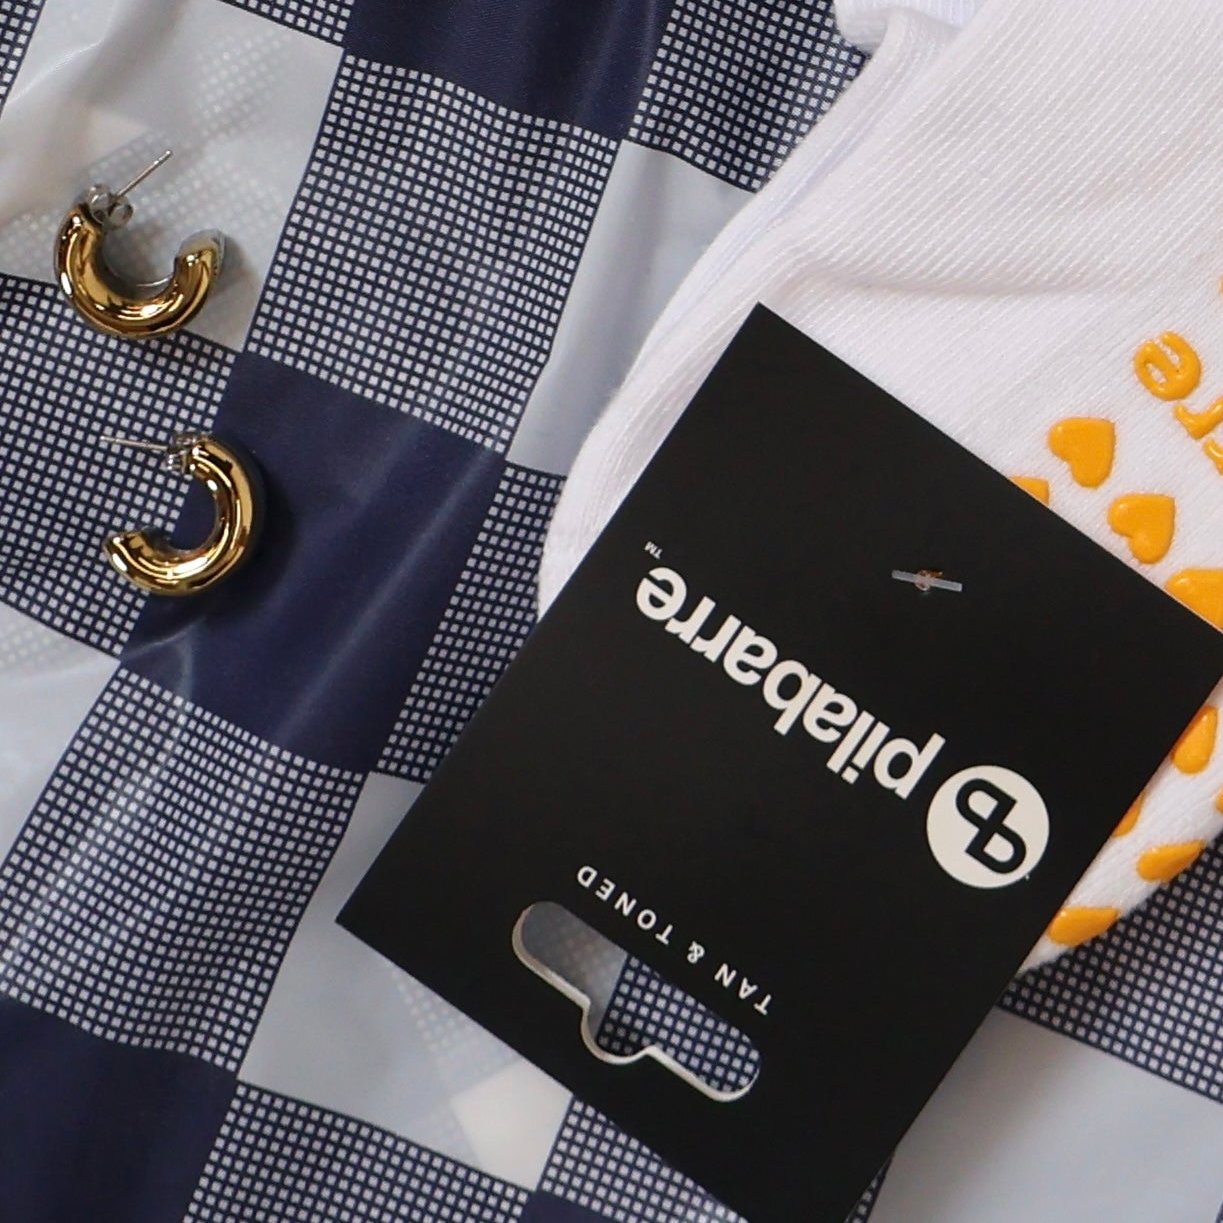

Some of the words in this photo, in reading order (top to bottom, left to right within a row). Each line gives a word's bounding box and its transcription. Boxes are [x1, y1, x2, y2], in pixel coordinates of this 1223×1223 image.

[635, 566, 946, 800] pilabarre
[576, 865, 673, 945] TONED
[687, 940, 705, 964] &
[714, 963, 772, 1015] TAN
